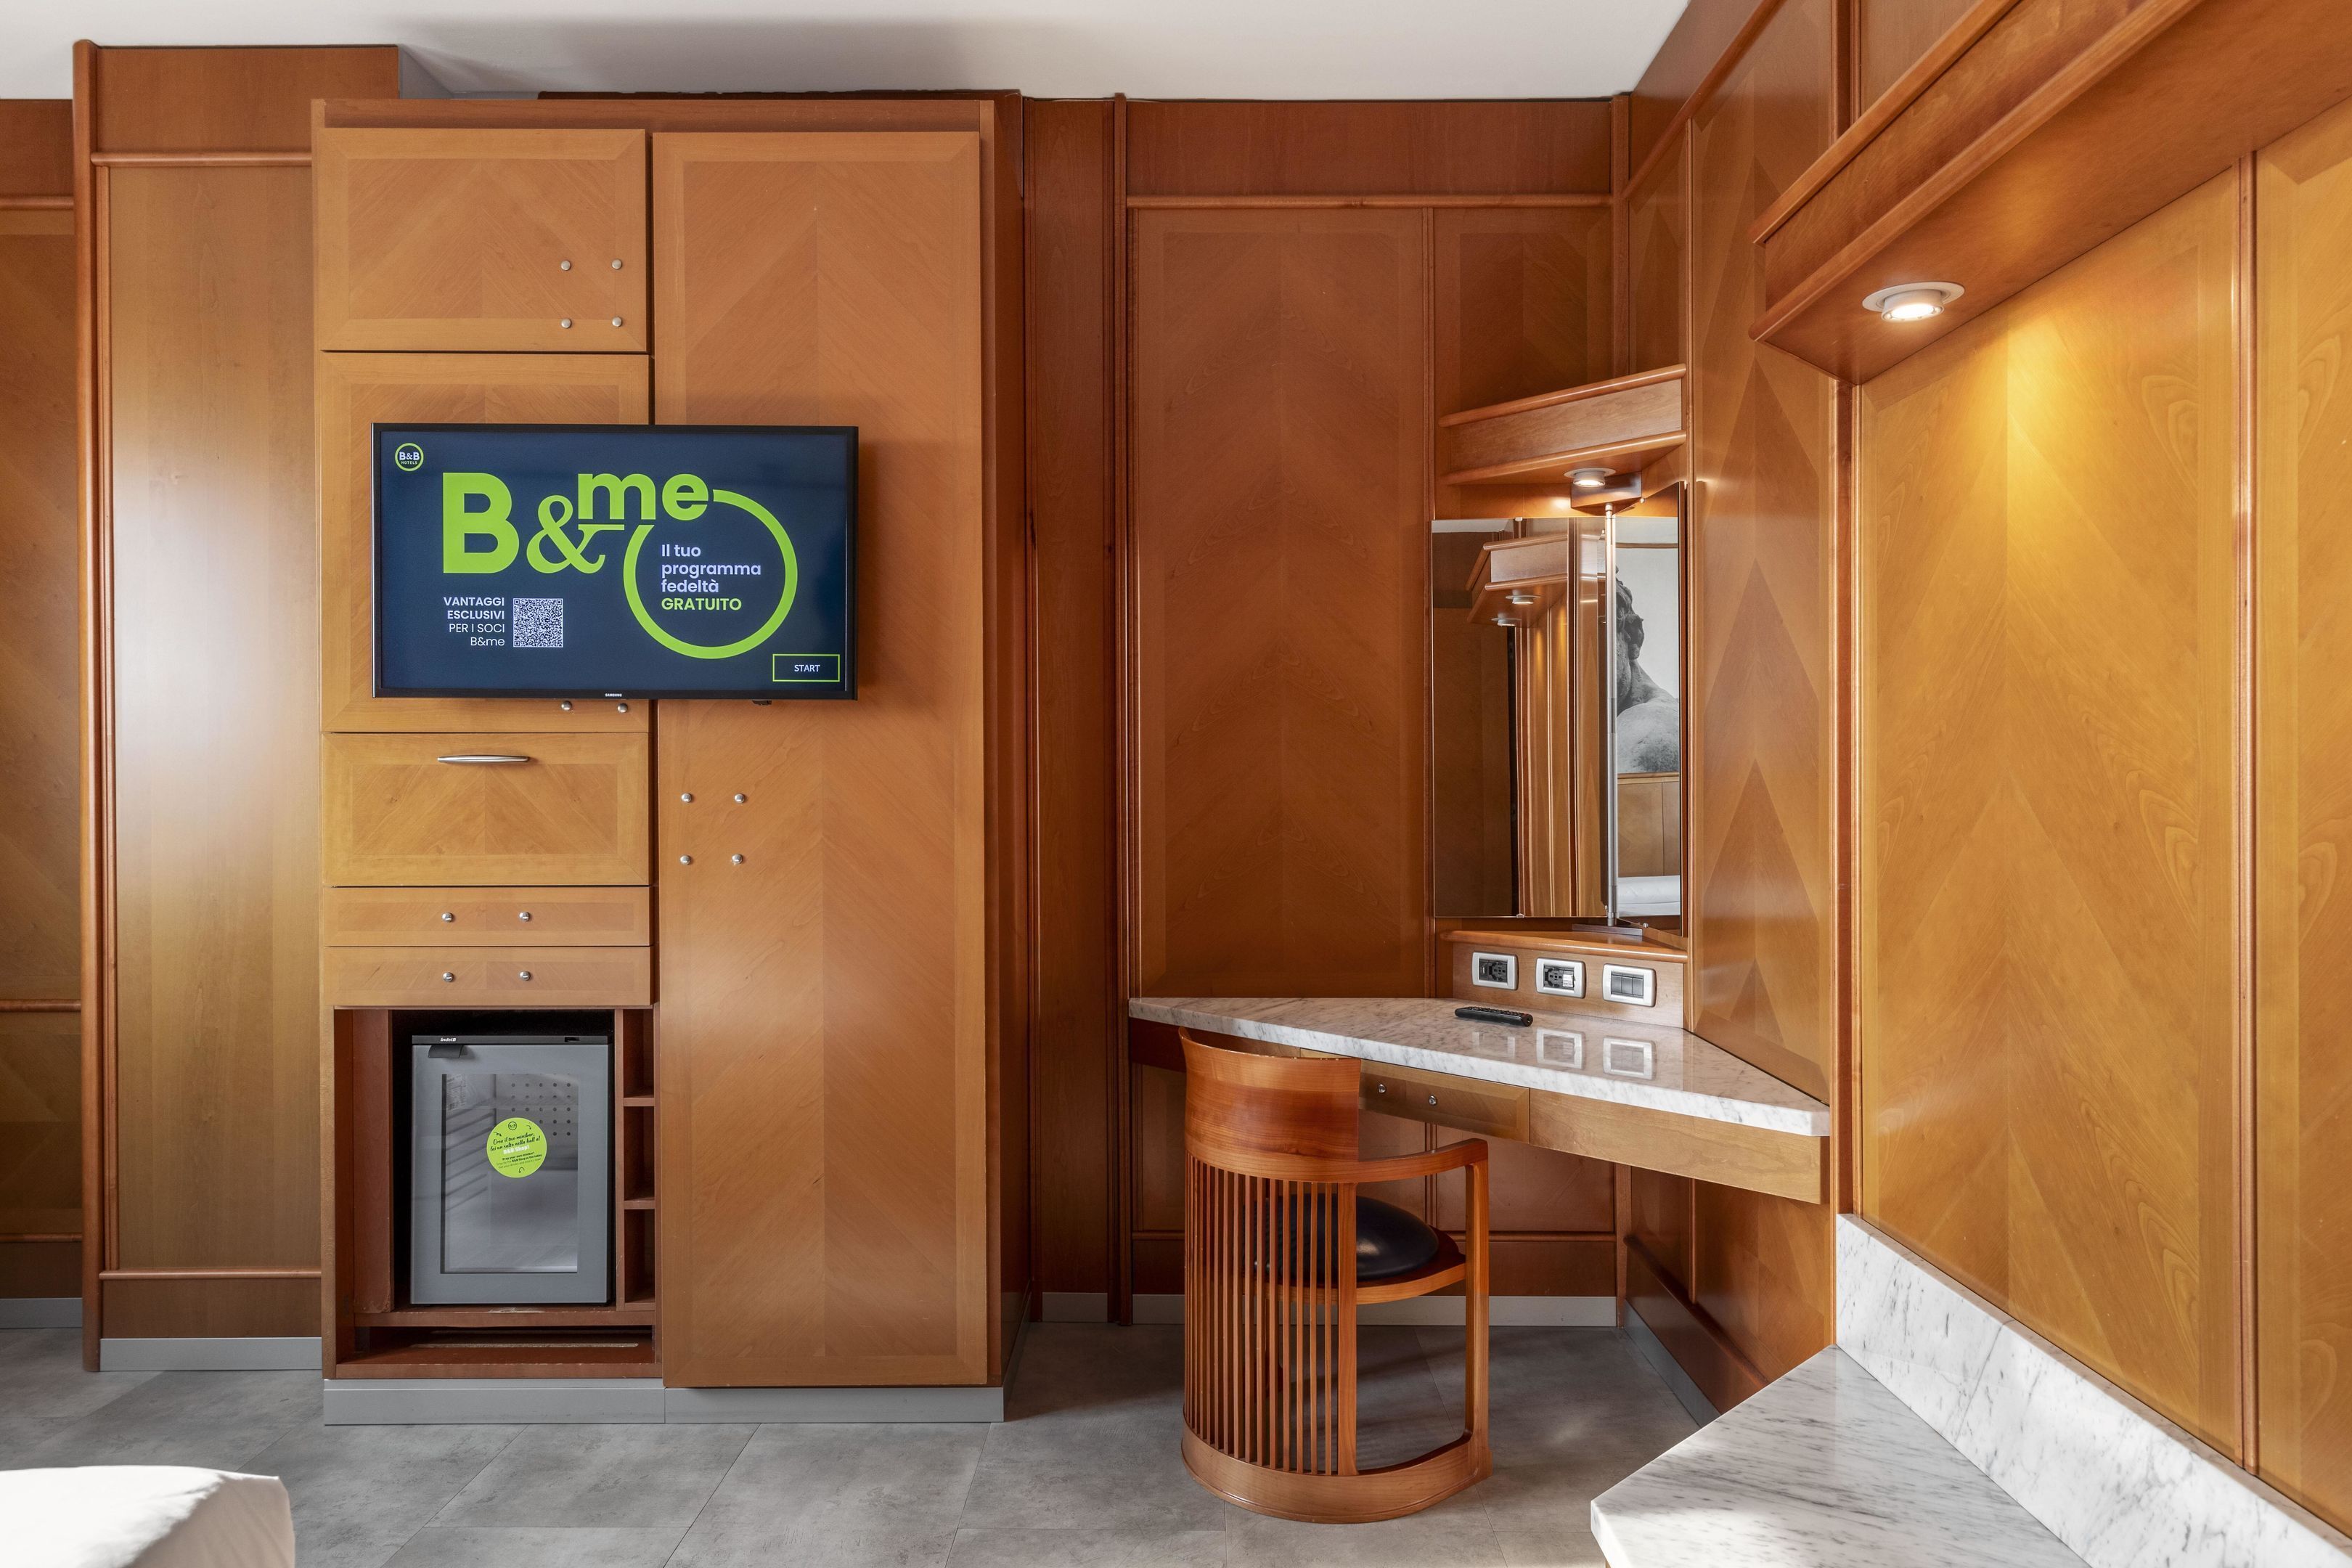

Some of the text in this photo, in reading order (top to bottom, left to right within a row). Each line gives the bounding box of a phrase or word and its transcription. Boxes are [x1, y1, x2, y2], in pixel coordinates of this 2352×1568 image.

[399, 452, 420, 460] B&B
[661, 544, 701, 557] Il tuo
[661, 564, 761, 579] programma
[661, 579, 719, 592] fedeltà
[444, 597, 505, 606] VANTAGGI
[661, 598, 742, 611] GRATUITO
[447, 611, 505, 619] ESCLUSIVI
[449, 624, 505, 633] PER I SOCI
[470, 637, 505, 646] B&me
